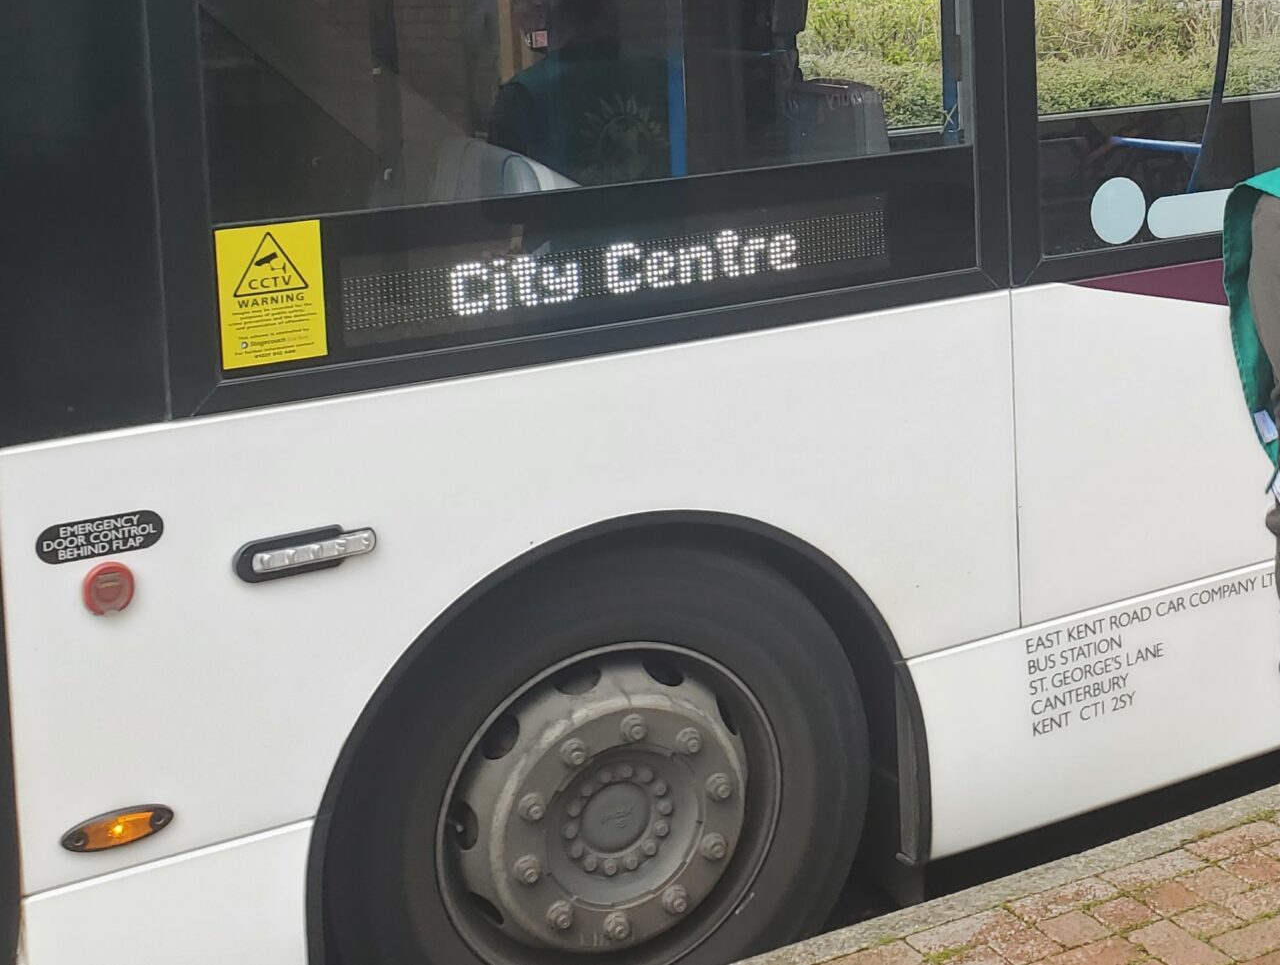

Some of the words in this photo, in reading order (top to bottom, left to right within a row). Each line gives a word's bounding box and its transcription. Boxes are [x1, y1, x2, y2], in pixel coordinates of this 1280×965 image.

[248, 275, 292, 290] CCTV
[449, 255, 580, 317] City
[606, 229, 798, 295] Centre
[237, 292, 305, 309] WARNING
[42, 535, 87, 553] DOOR
[90, 523, 157, 544] CONTROL
[59, 514, 140, 538] EMERGENCY
[57, 543, 110, 561] BEHIND
[112, 535, 144, 551] FLAP
[1025, 629, 1063, 655] EAST
[1067, 618, 1105, 643] KENT
[1109, 606, 1151, 631] ROAD
[1155, 596, 1186, 618] CAR
[1189, 576, 1258, 608] COMPANY
[1261, 572, 1275, 589] LT
[1027, 652, 1056, 675] BUS
[1060, 635, 1123, 666] STATION
[1029, 677, 1048, 696] ST.
[1051, 655, 1122, 690] GEORGE'S
[1126, 642, 1165, 667] LANE
[1031, 673, 1130, 716] CANTERBURY
[1033, 711, 1072, 737] KENT
[1111, 690, 1137, 712] 2SY
